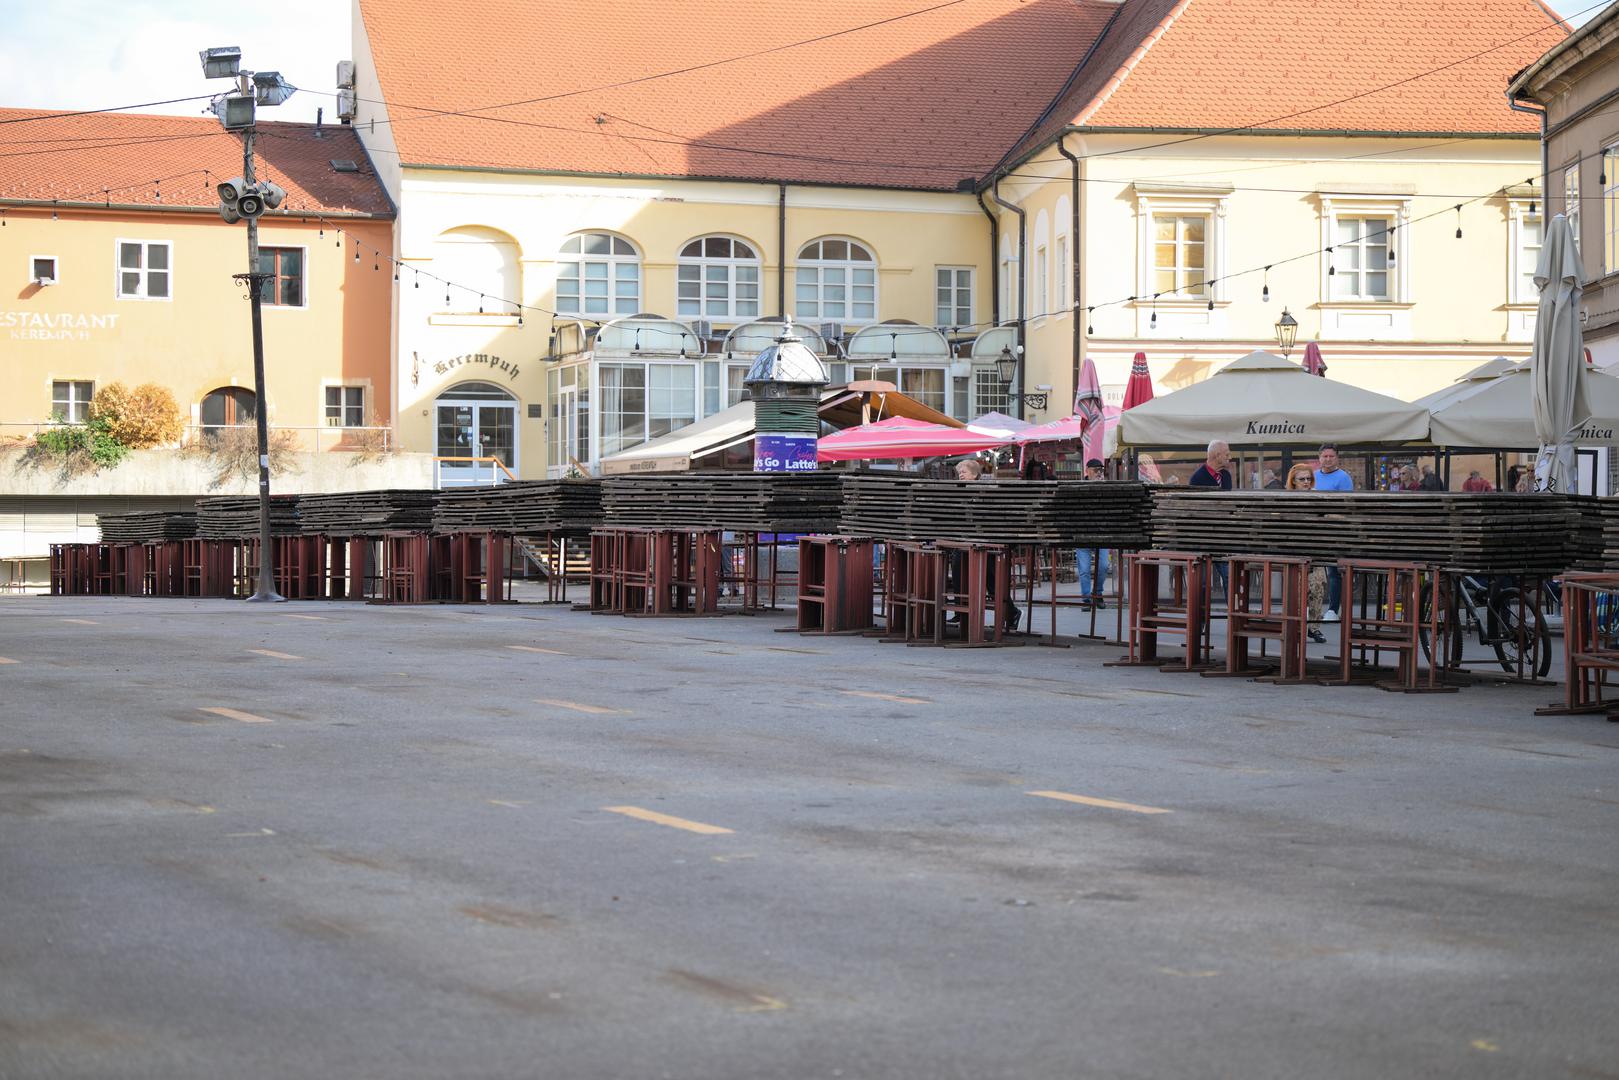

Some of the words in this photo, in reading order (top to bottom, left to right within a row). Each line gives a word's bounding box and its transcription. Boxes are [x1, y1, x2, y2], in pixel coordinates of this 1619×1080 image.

[433, 353, 520, 380] Kerempuh
[1246, 420, 1305, 434] Kumica
[764, 457, 780, 467] Go
